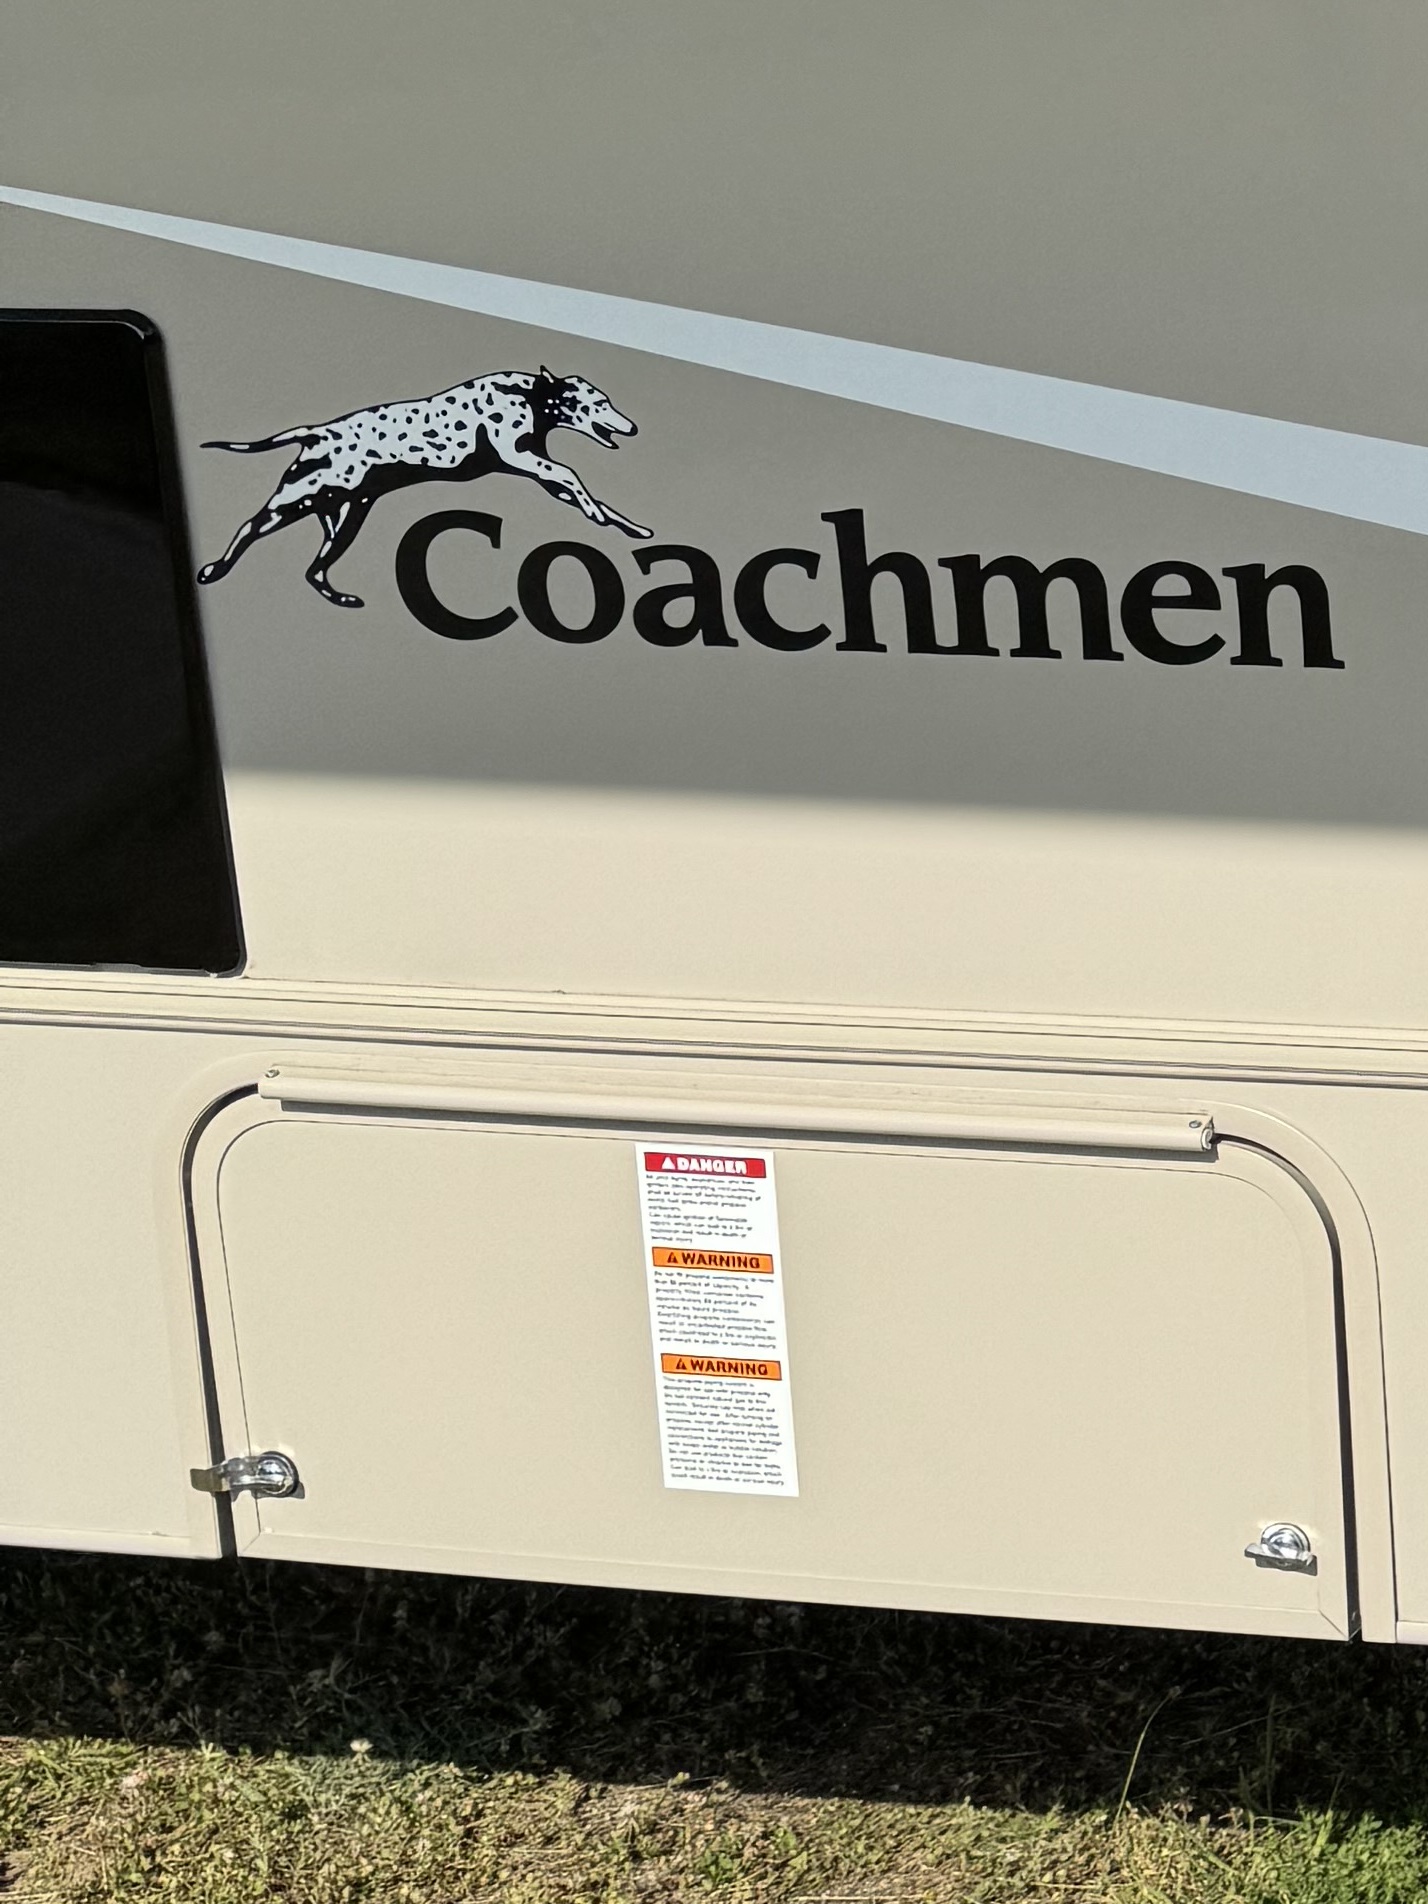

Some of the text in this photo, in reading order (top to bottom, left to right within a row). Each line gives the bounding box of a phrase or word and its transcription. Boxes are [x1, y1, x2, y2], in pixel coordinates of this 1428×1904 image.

[396, 508, 1346, 670] Coachmen
[677, 1157, 748, 1175] DANGER
[681, 1252, 761, 1269] WARNING
[690, 1358, 769, 1376] WARNING
